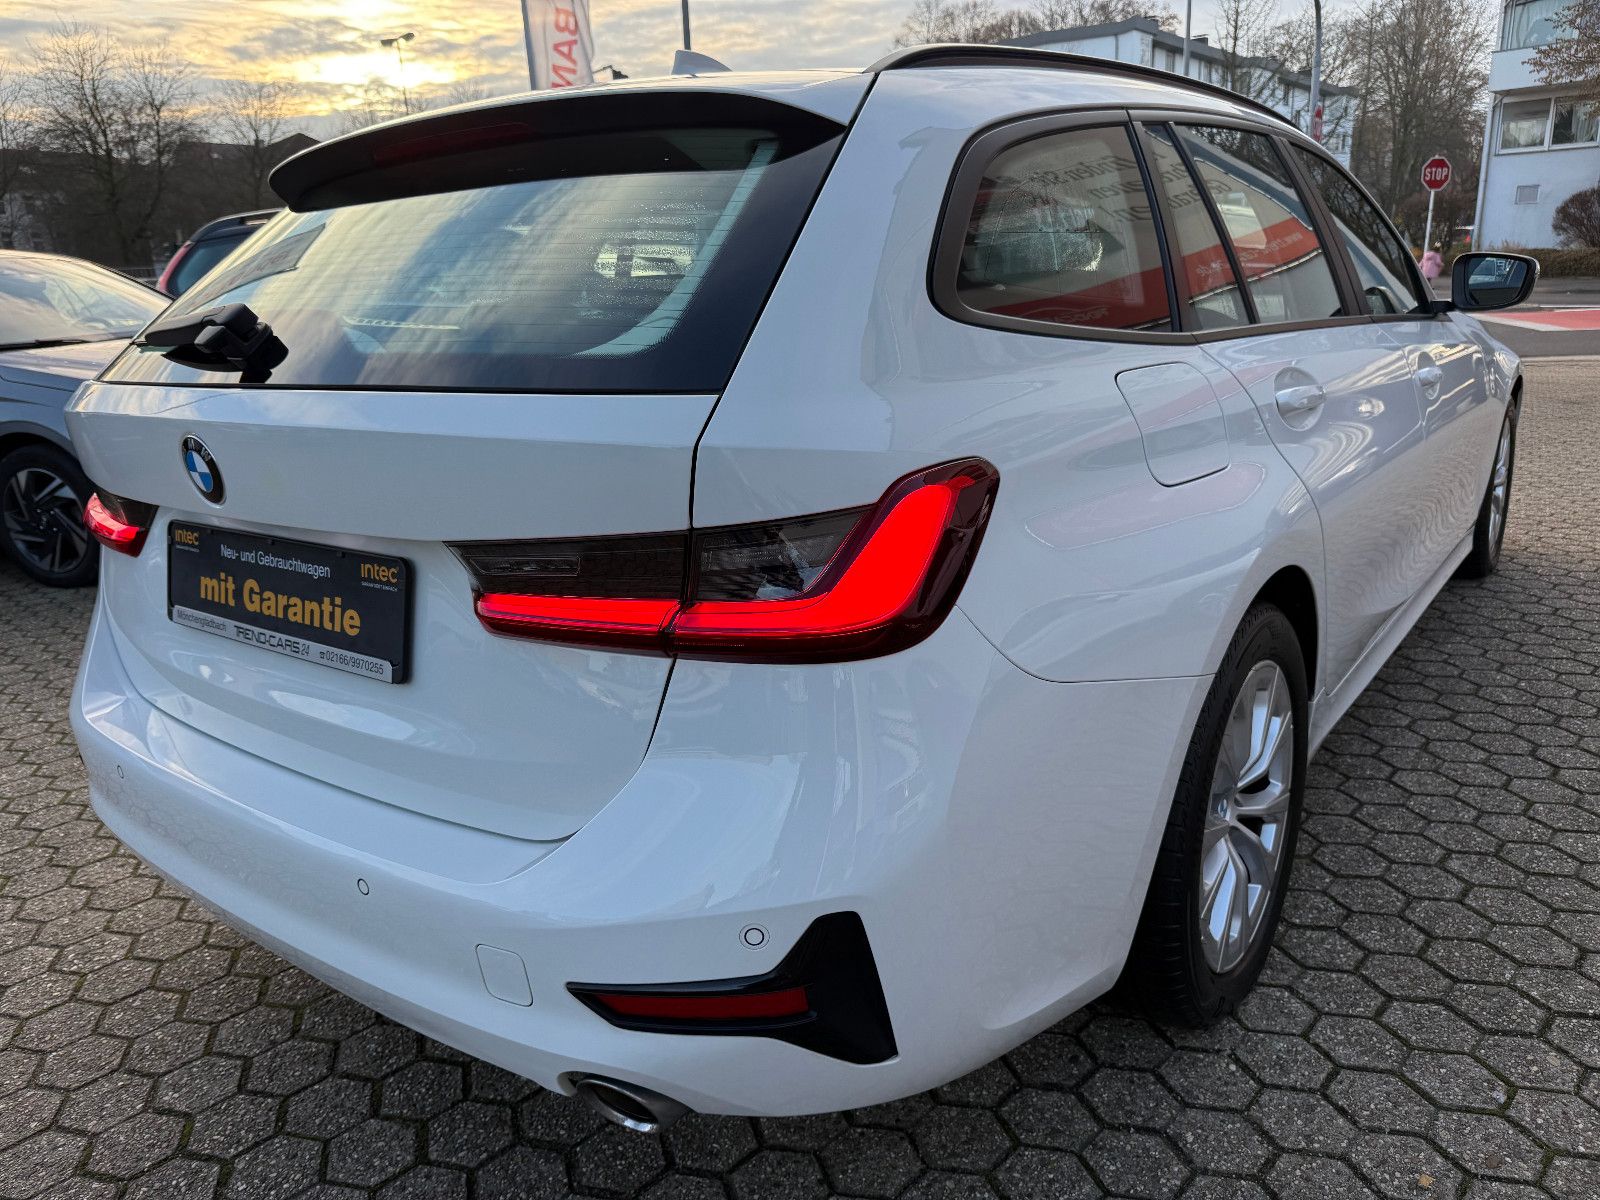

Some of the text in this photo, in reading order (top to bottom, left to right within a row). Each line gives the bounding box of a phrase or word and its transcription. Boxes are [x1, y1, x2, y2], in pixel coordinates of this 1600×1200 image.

[1425, 167, 1448, 181] STOP
[220, 543, 331, 579] Neu- und Gebrauchtwagen
[361, 561, 398, 583] intec
[200, 572, 361, 636] mit Garantie
[301, 643, 310, 656] 24
